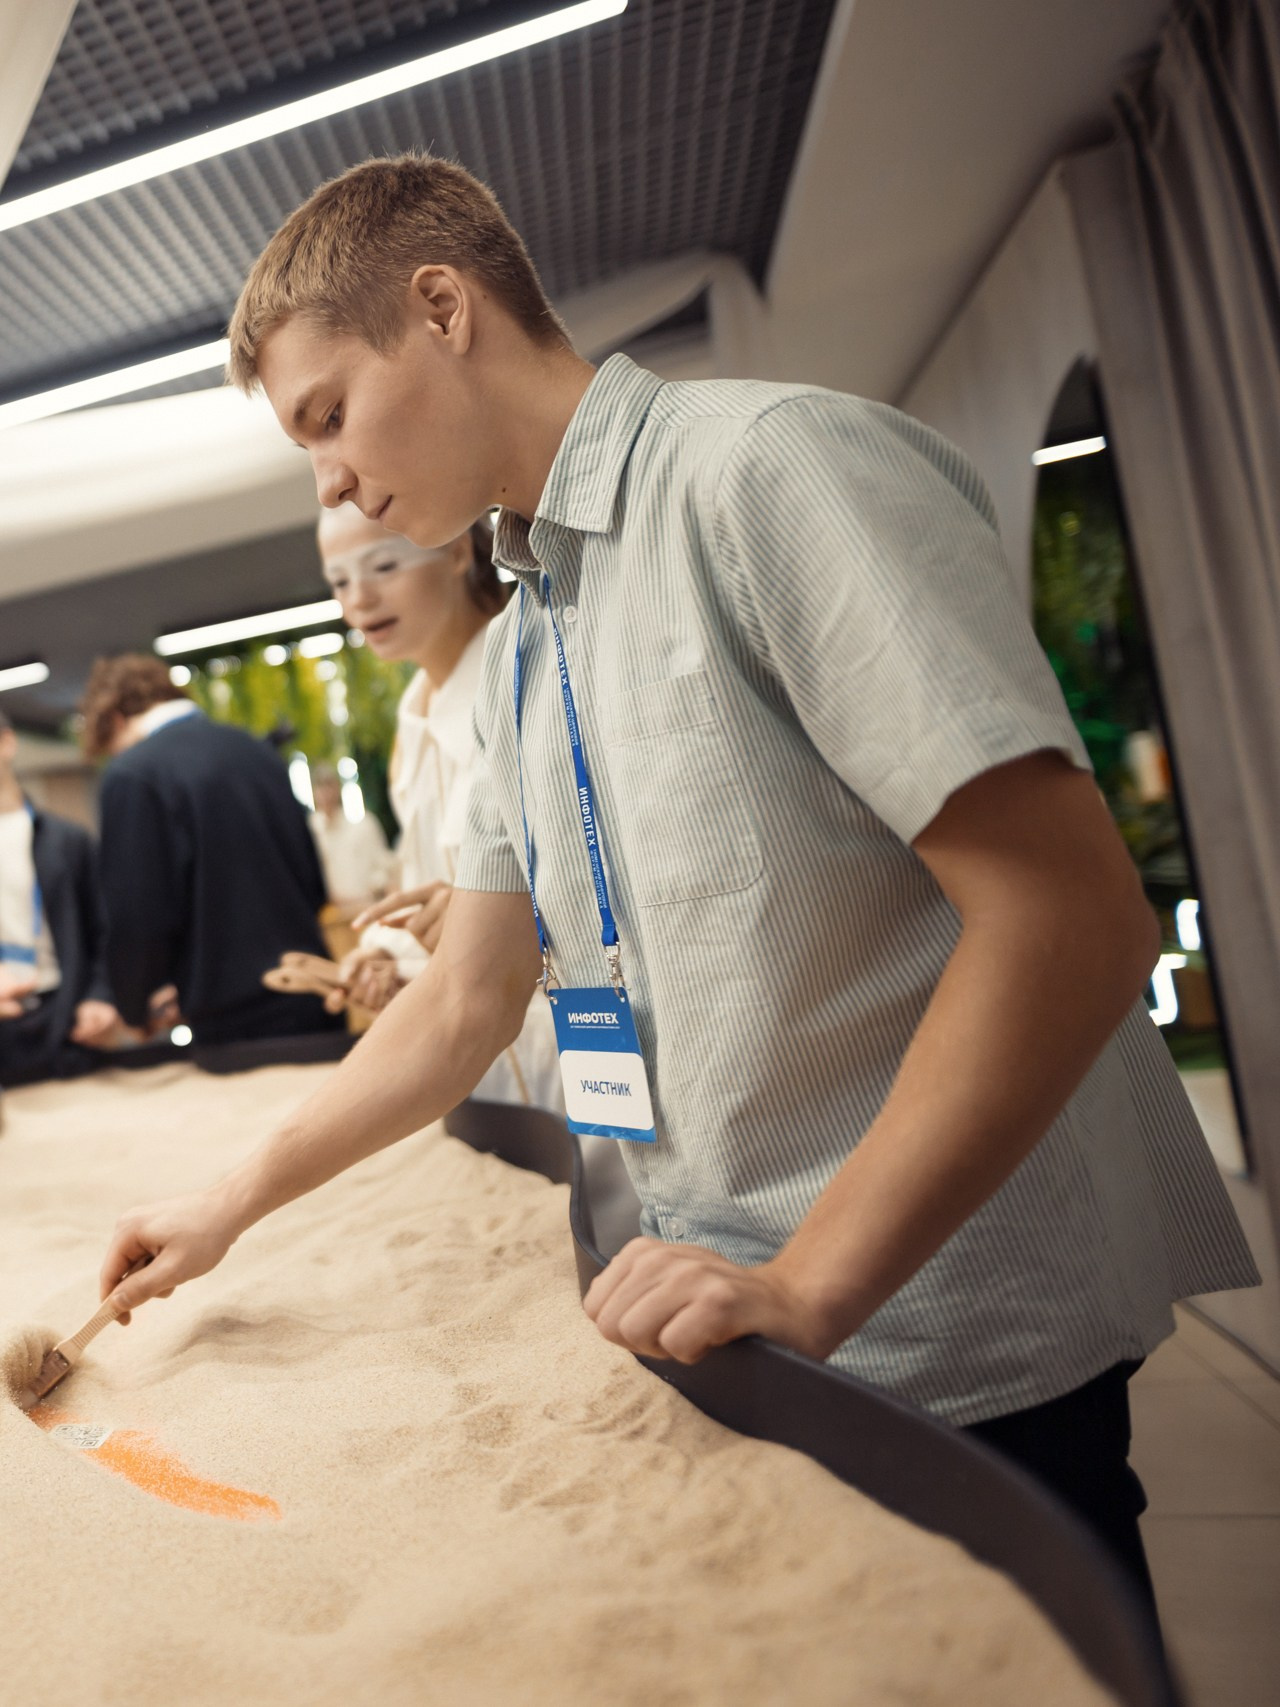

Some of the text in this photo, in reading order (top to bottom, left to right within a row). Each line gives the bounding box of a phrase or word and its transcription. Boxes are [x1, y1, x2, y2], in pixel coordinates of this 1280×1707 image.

[579, 787, 596, 846] ИНФОТЕХ
[567, 1012, 619, 1025] ИНФОТЕХ
[580, 1080, 632, 1097] УЧАСТНИК
